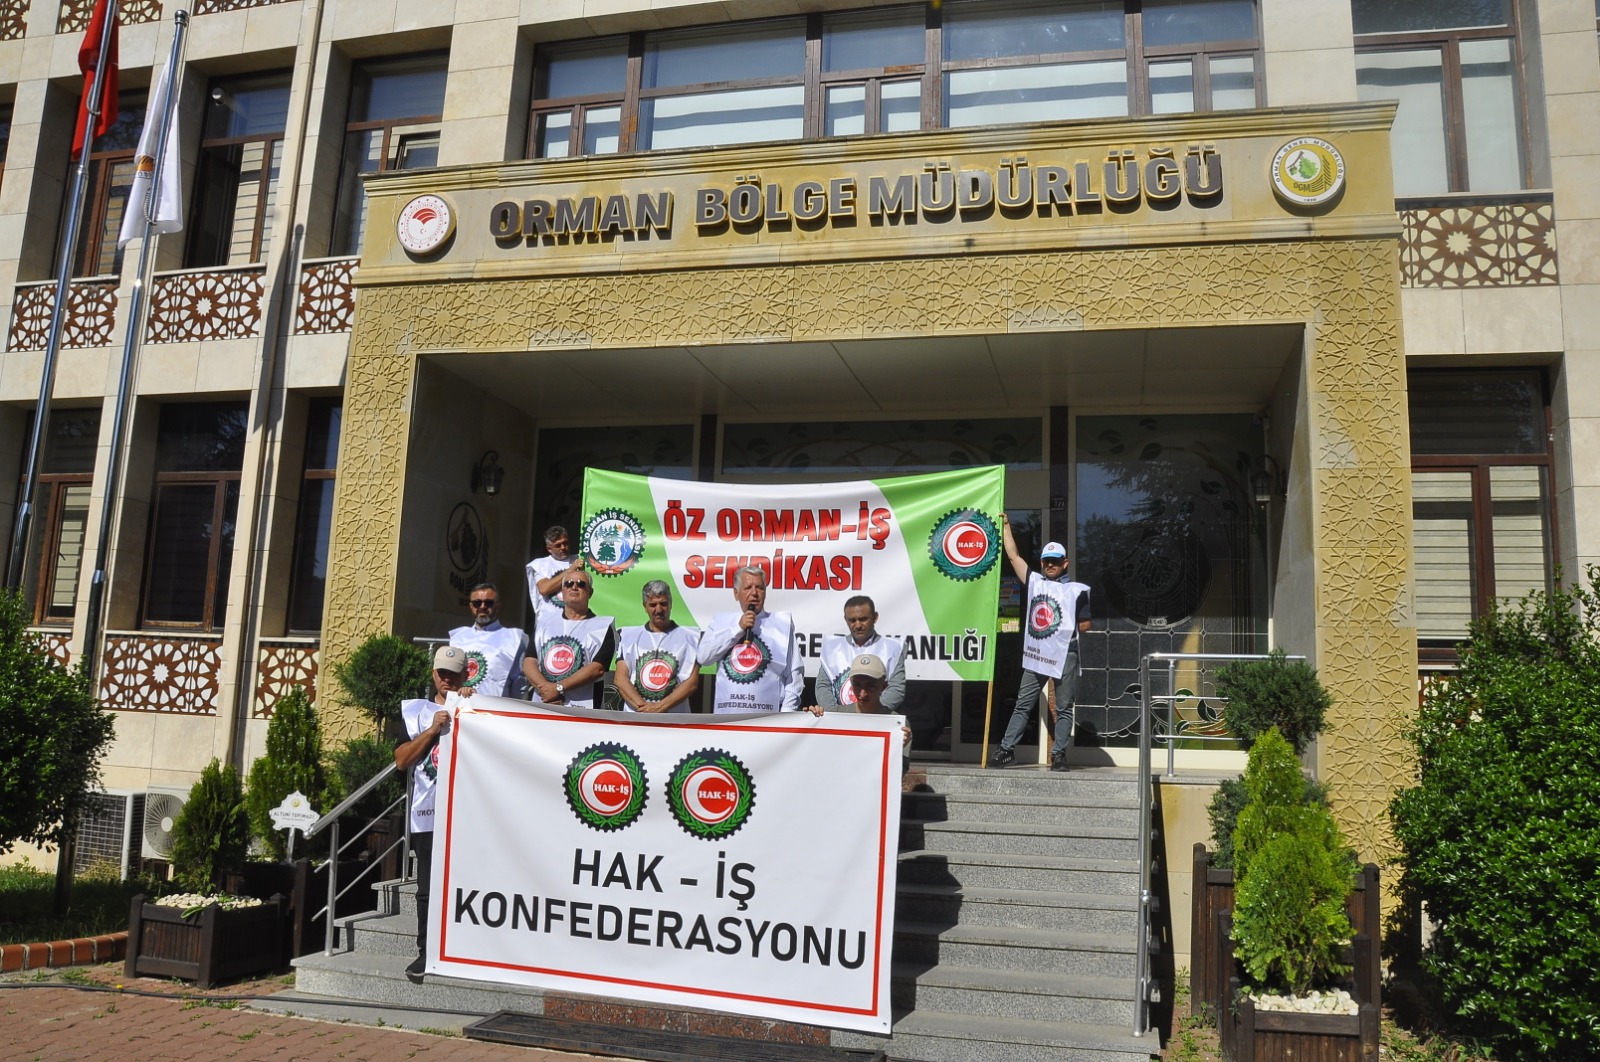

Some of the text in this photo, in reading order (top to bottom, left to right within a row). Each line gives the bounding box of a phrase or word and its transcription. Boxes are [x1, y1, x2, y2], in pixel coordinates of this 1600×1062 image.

[1274, 155, 1282, 183] ORMAN
[1283, 140, 1308, 153] GENEL
[489, 190, 672, 239] ORMAN
[695, 175, 855, 226] BÖLGE
[868, 144, 1223, 215] MÜDÜRLÜĞÜ
[1293, 182, 1311, 192] OGM
[584, 514, 608, 539] ORMAN
[609, 511, 617, 519] İŞ
[619, 514, 642, 554] SENDİKASI
[664, 499, 891, 550] ÖZ ORMAN-İŞ
[957, 541, 984, 549] HAK-İŞ
[683, 549, 863, 591] SENDİKASI
[717, 701, 773, 710] FEDERASYONU
[730, 693, 755, 702] HAK-İŞ
[594, 782, 629, 796] HAK-İŞ
[699, 790, 735, 802] HAK-İŞ
[572, 848, 664, 893] HAK
[715, 850, 756, 911] İŞ
[454, 888, 867, 969] KONFEDERASYONU
